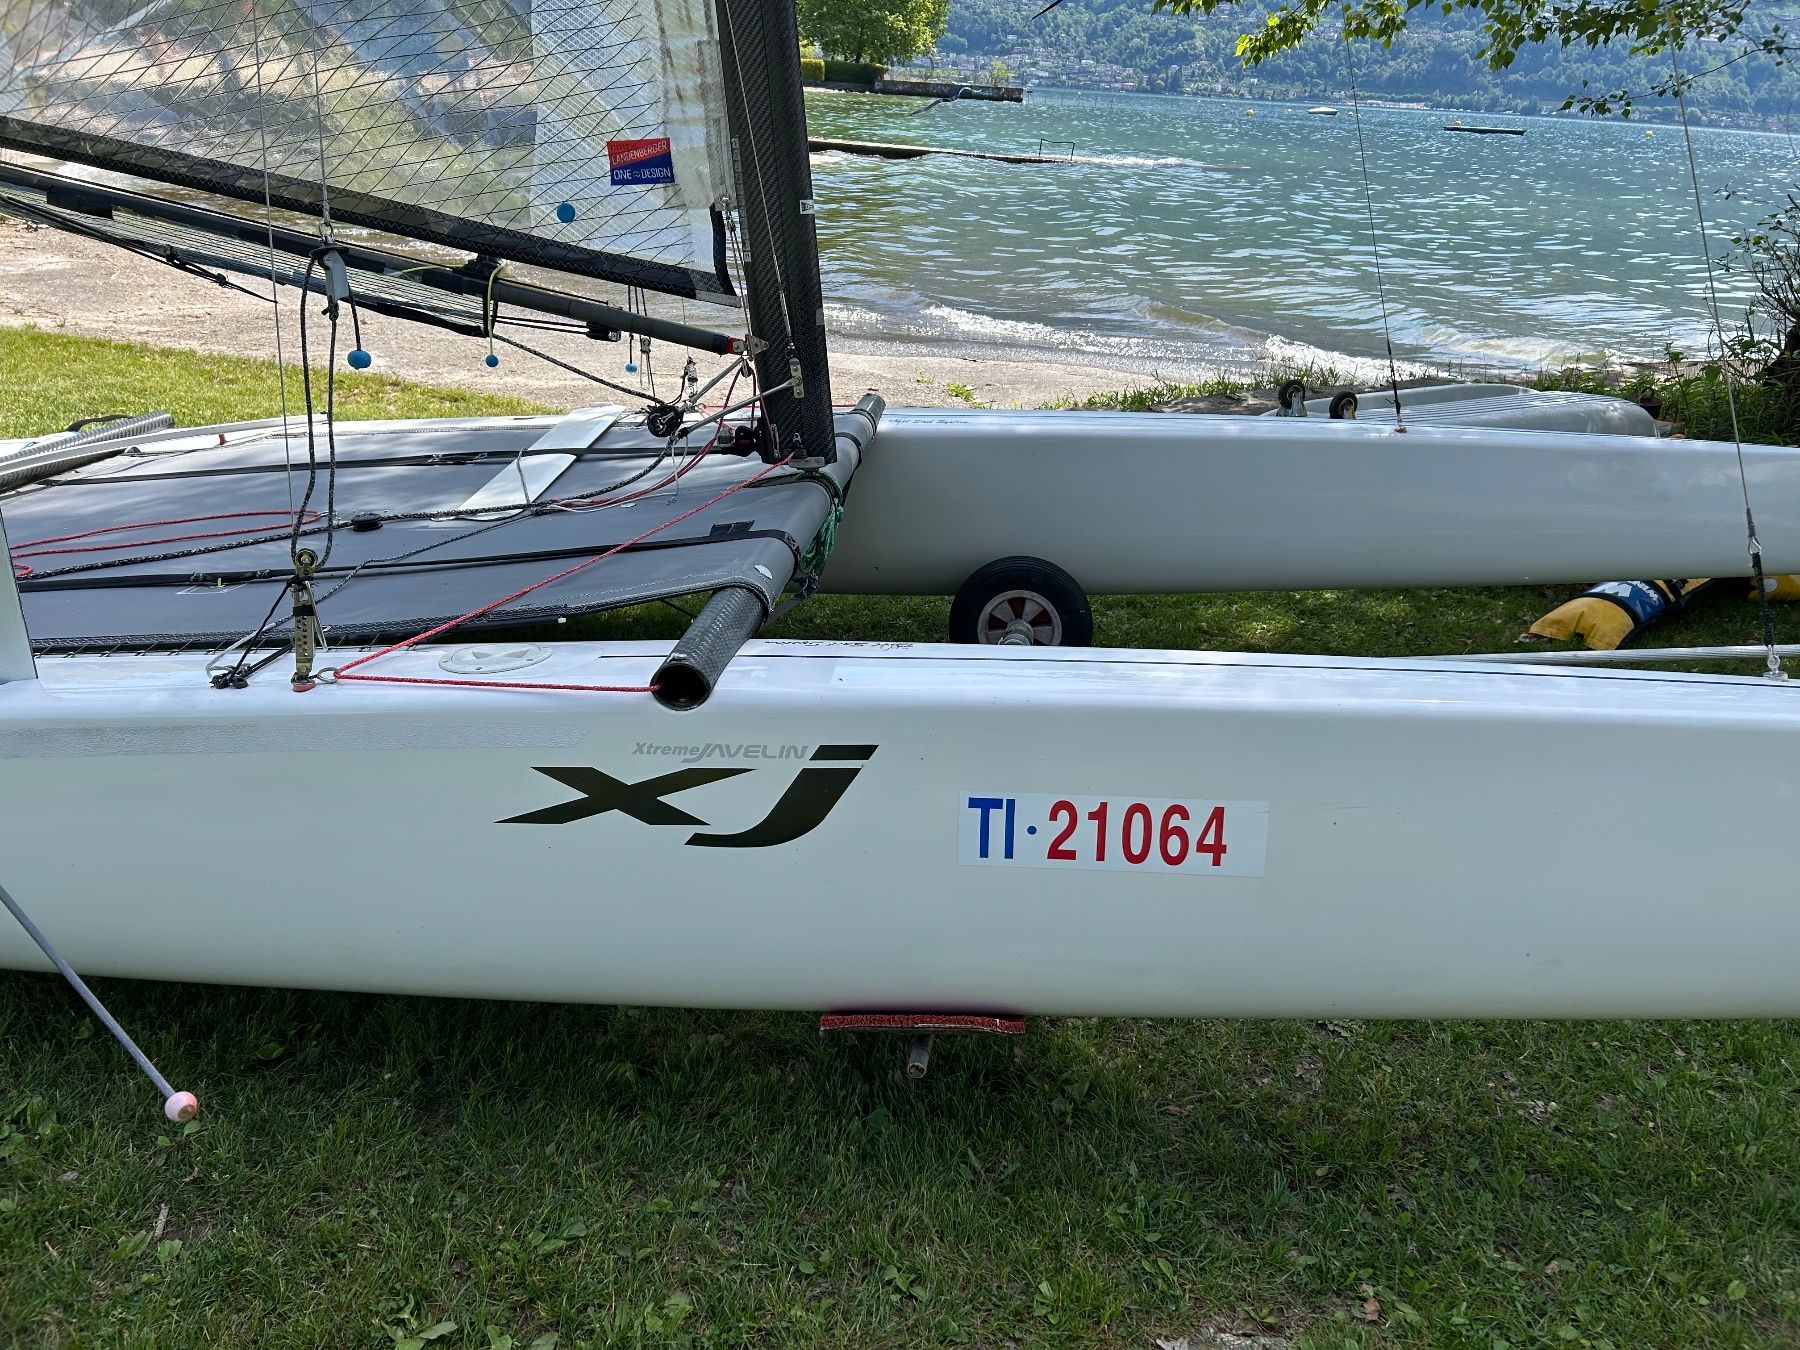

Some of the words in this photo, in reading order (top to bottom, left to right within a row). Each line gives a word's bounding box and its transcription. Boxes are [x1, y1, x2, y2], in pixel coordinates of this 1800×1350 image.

[611, 140, 667, 166] LANDENBERGER
[613, 168, 632, 180] ONE
[640, 166, 671, 179] DESIGN
[1046, 800, 1227, 866] 21064
